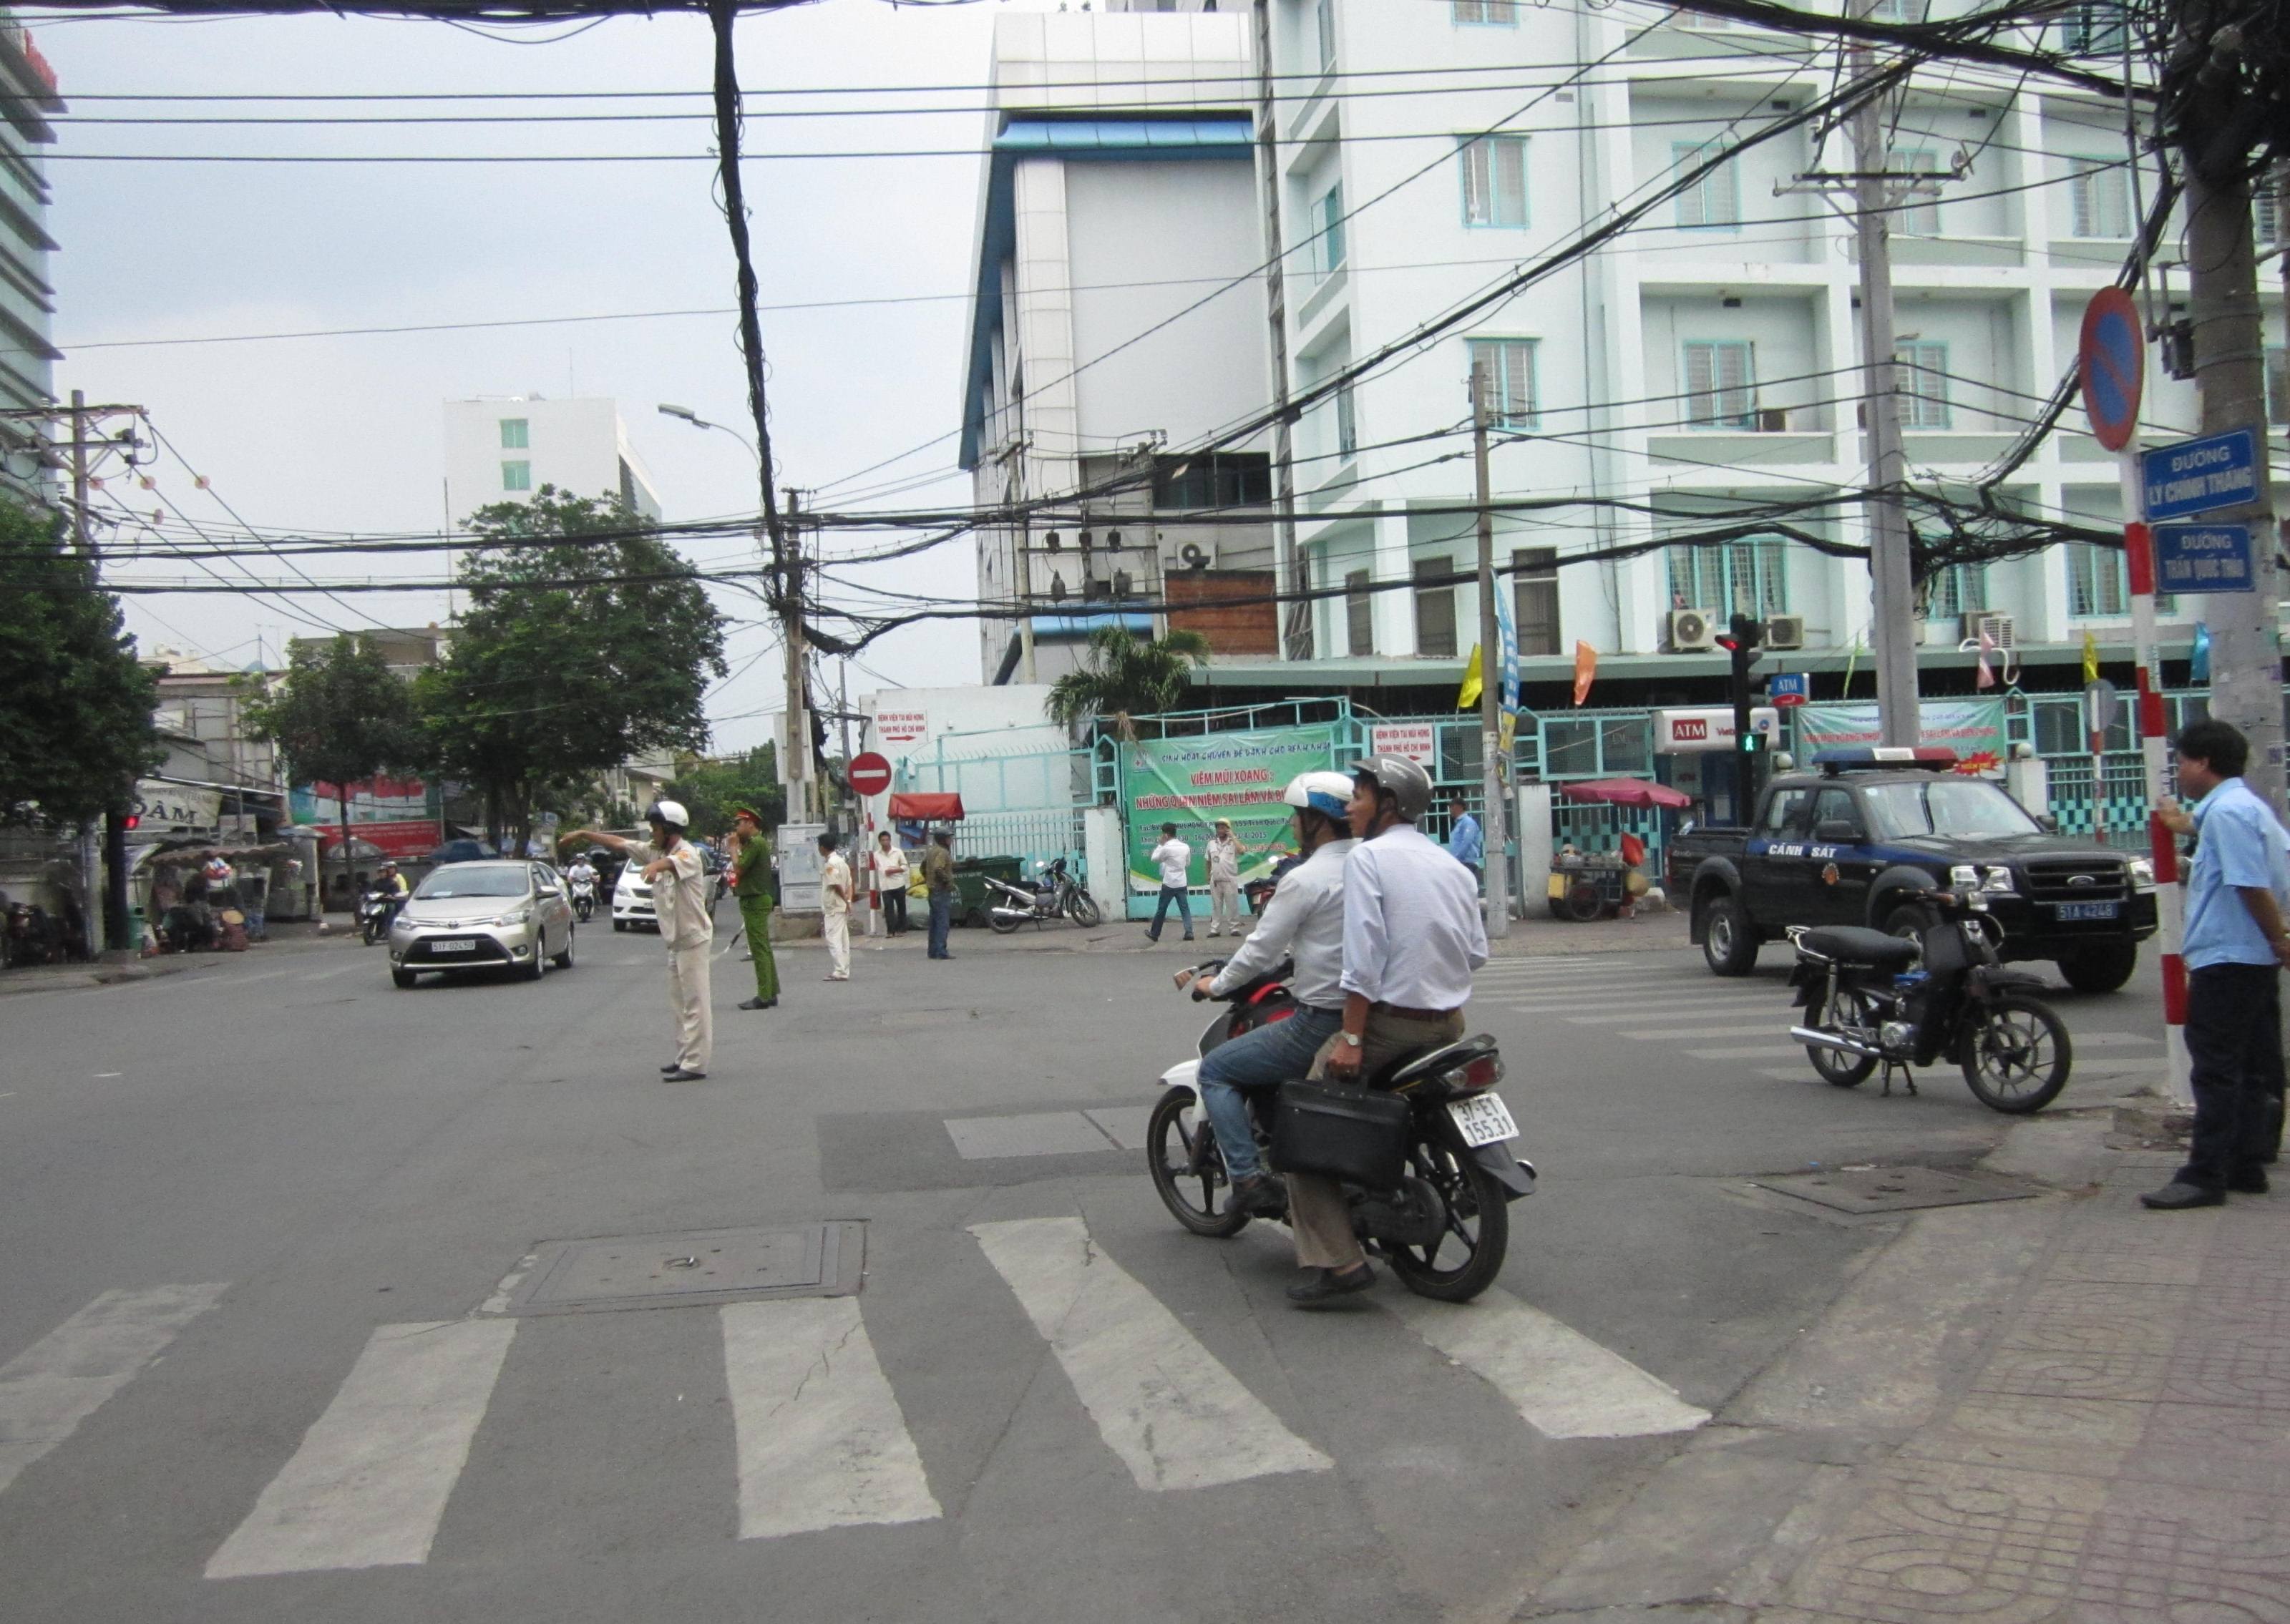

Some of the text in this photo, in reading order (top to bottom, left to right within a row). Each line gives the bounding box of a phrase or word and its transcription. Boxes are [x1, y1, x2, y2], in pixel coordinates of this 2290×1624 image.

[1778, 679, 1797, 691] ATM
[1675, 723, 1705, 737] ATM
[1466, 1115, 1512, 1143] 155.31
